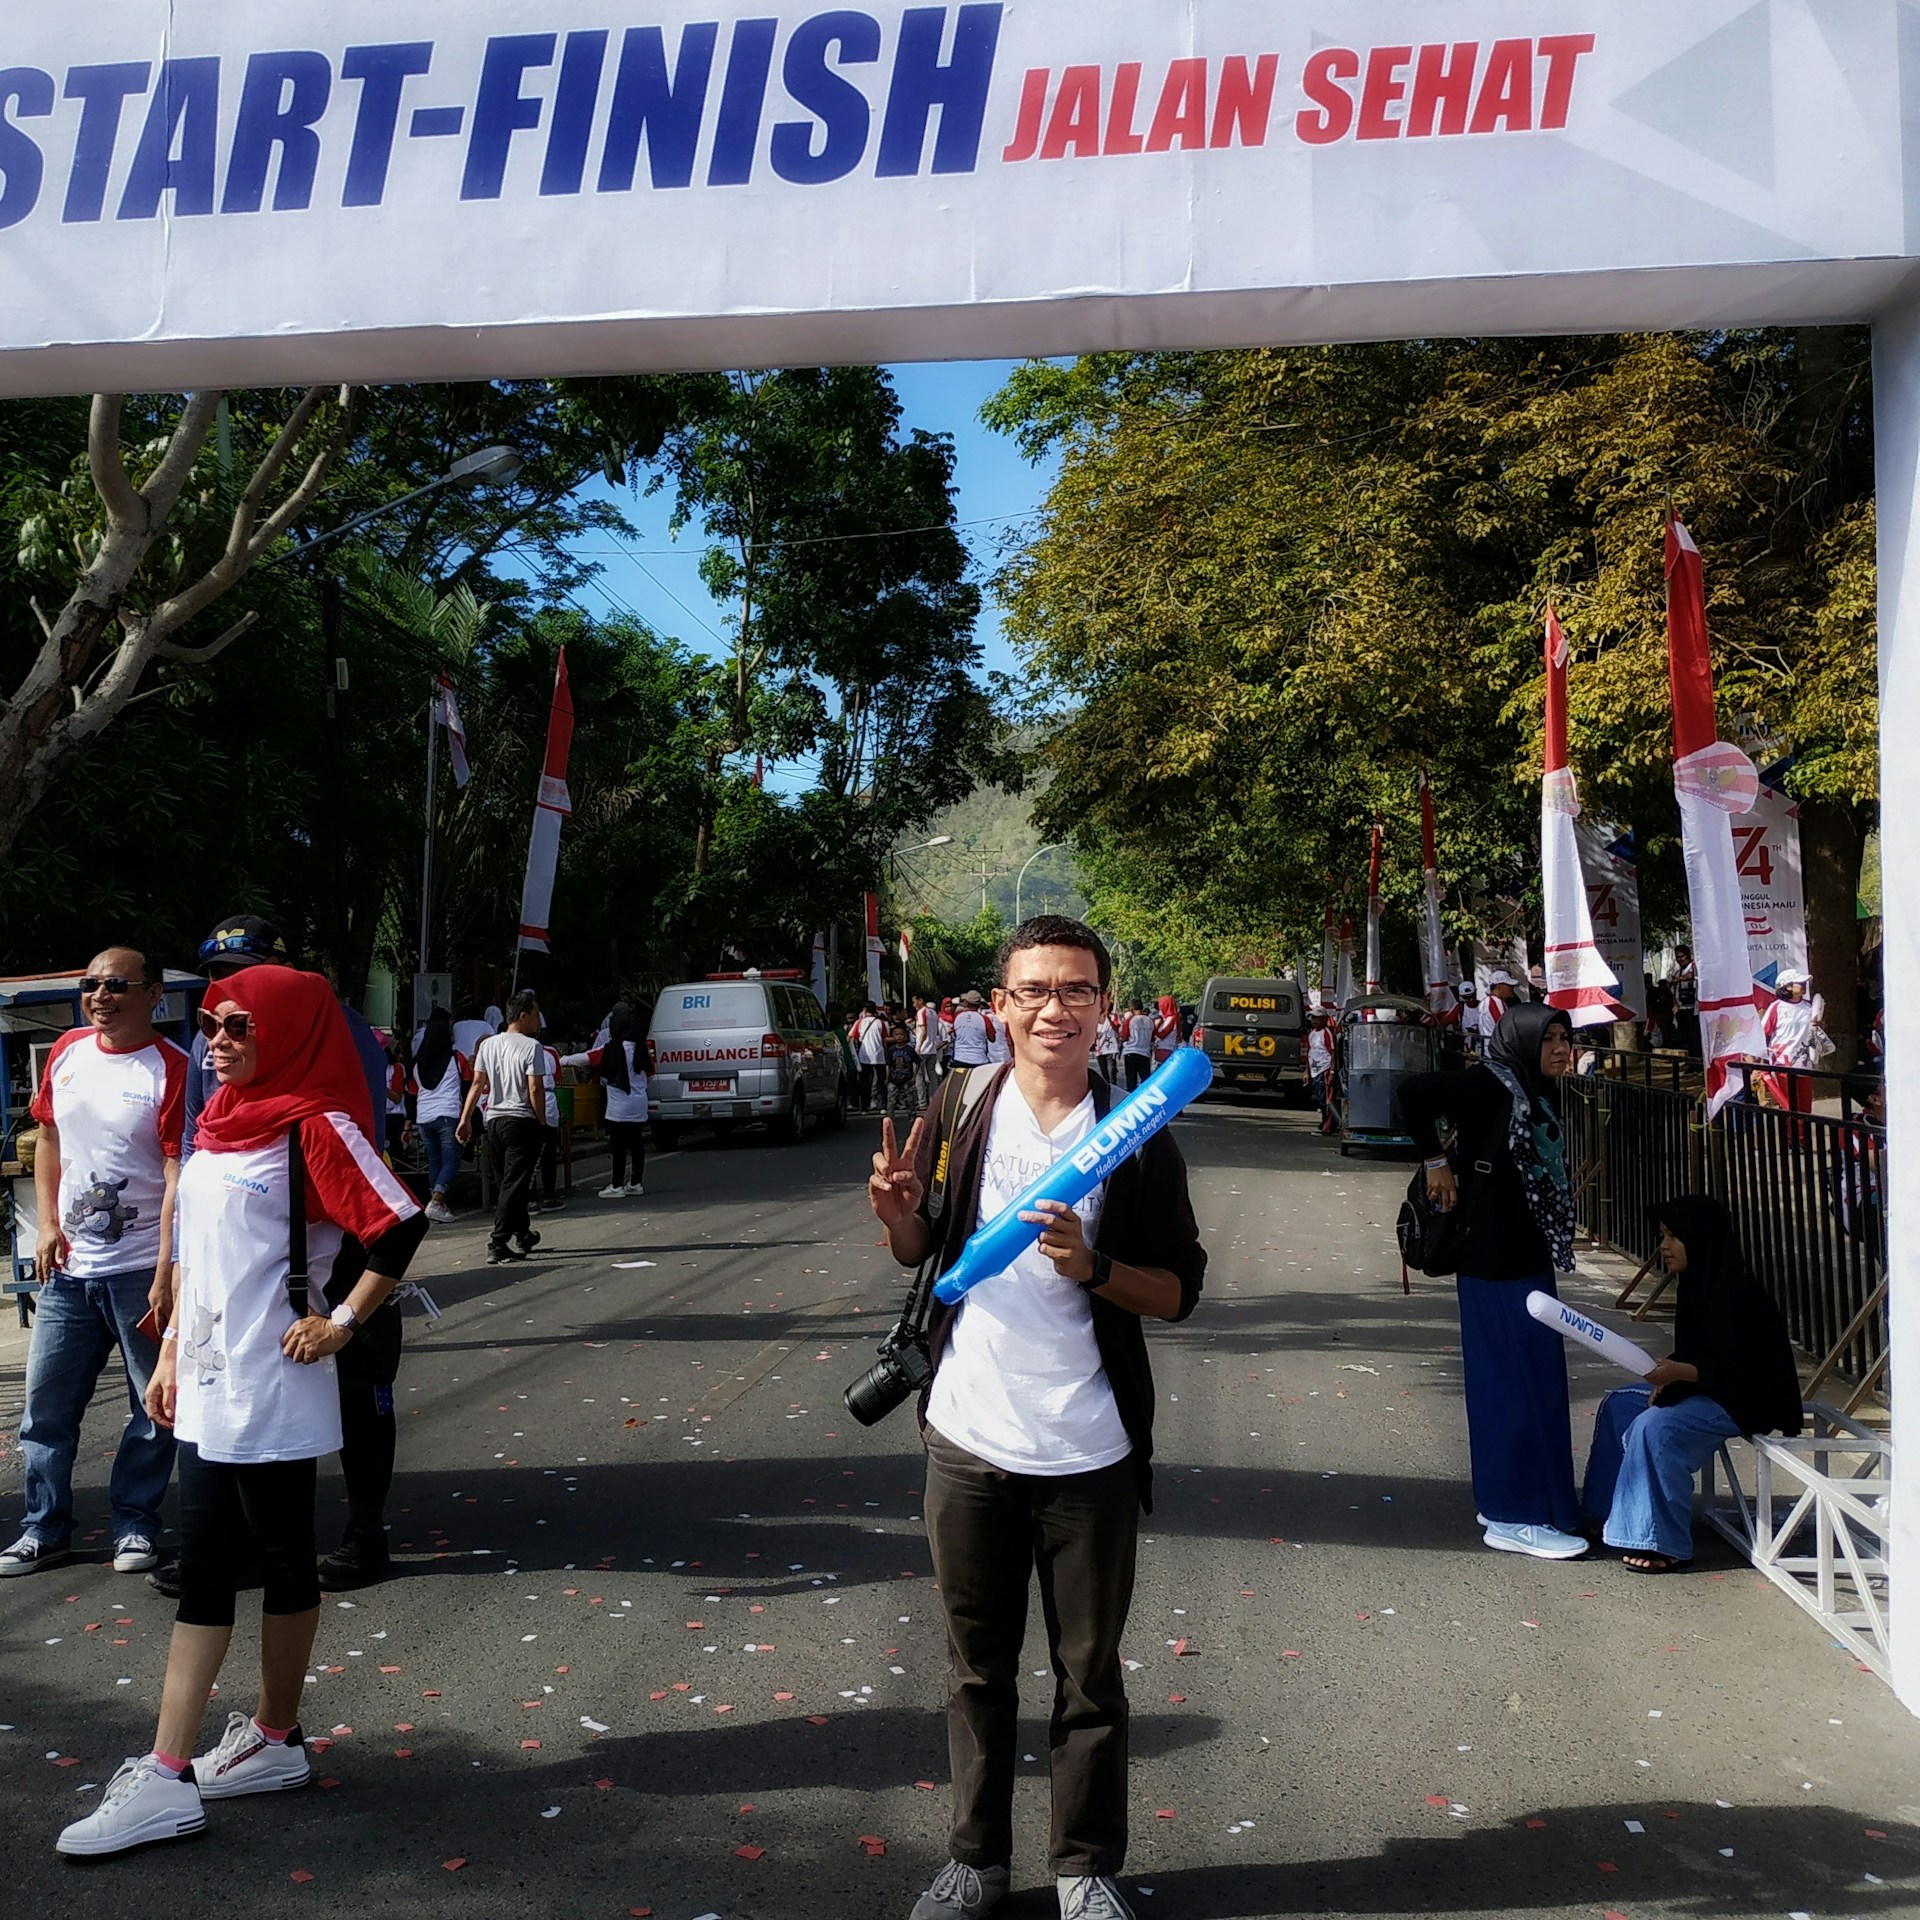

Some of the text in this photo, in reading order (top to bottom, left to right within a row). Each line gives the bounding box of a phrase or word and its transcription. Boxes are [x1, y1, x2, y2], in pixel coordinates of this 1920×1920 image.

[0, 2, 1595, 230] START-FINISH JALAN SEHAT
[682, 994, 711, 1010] BRI
[1229, 996, 1276, 1009] POLISI
[659, 1047, 759, 1063] AMBULANCE
[1224, 1034, 1277, 1057] K-9
[122, 1091, 156, 1104] BUMN
[1071, 1084, 1168, 1175] BUMN
[1095, 1106, 1167, 1178] Hadir untuk negeri
[935, 1140, 950, 1183] Nikon
[222, 1173, 270, 1194] BUMN
[1559, 1307, 1604, 1343] BUMN
